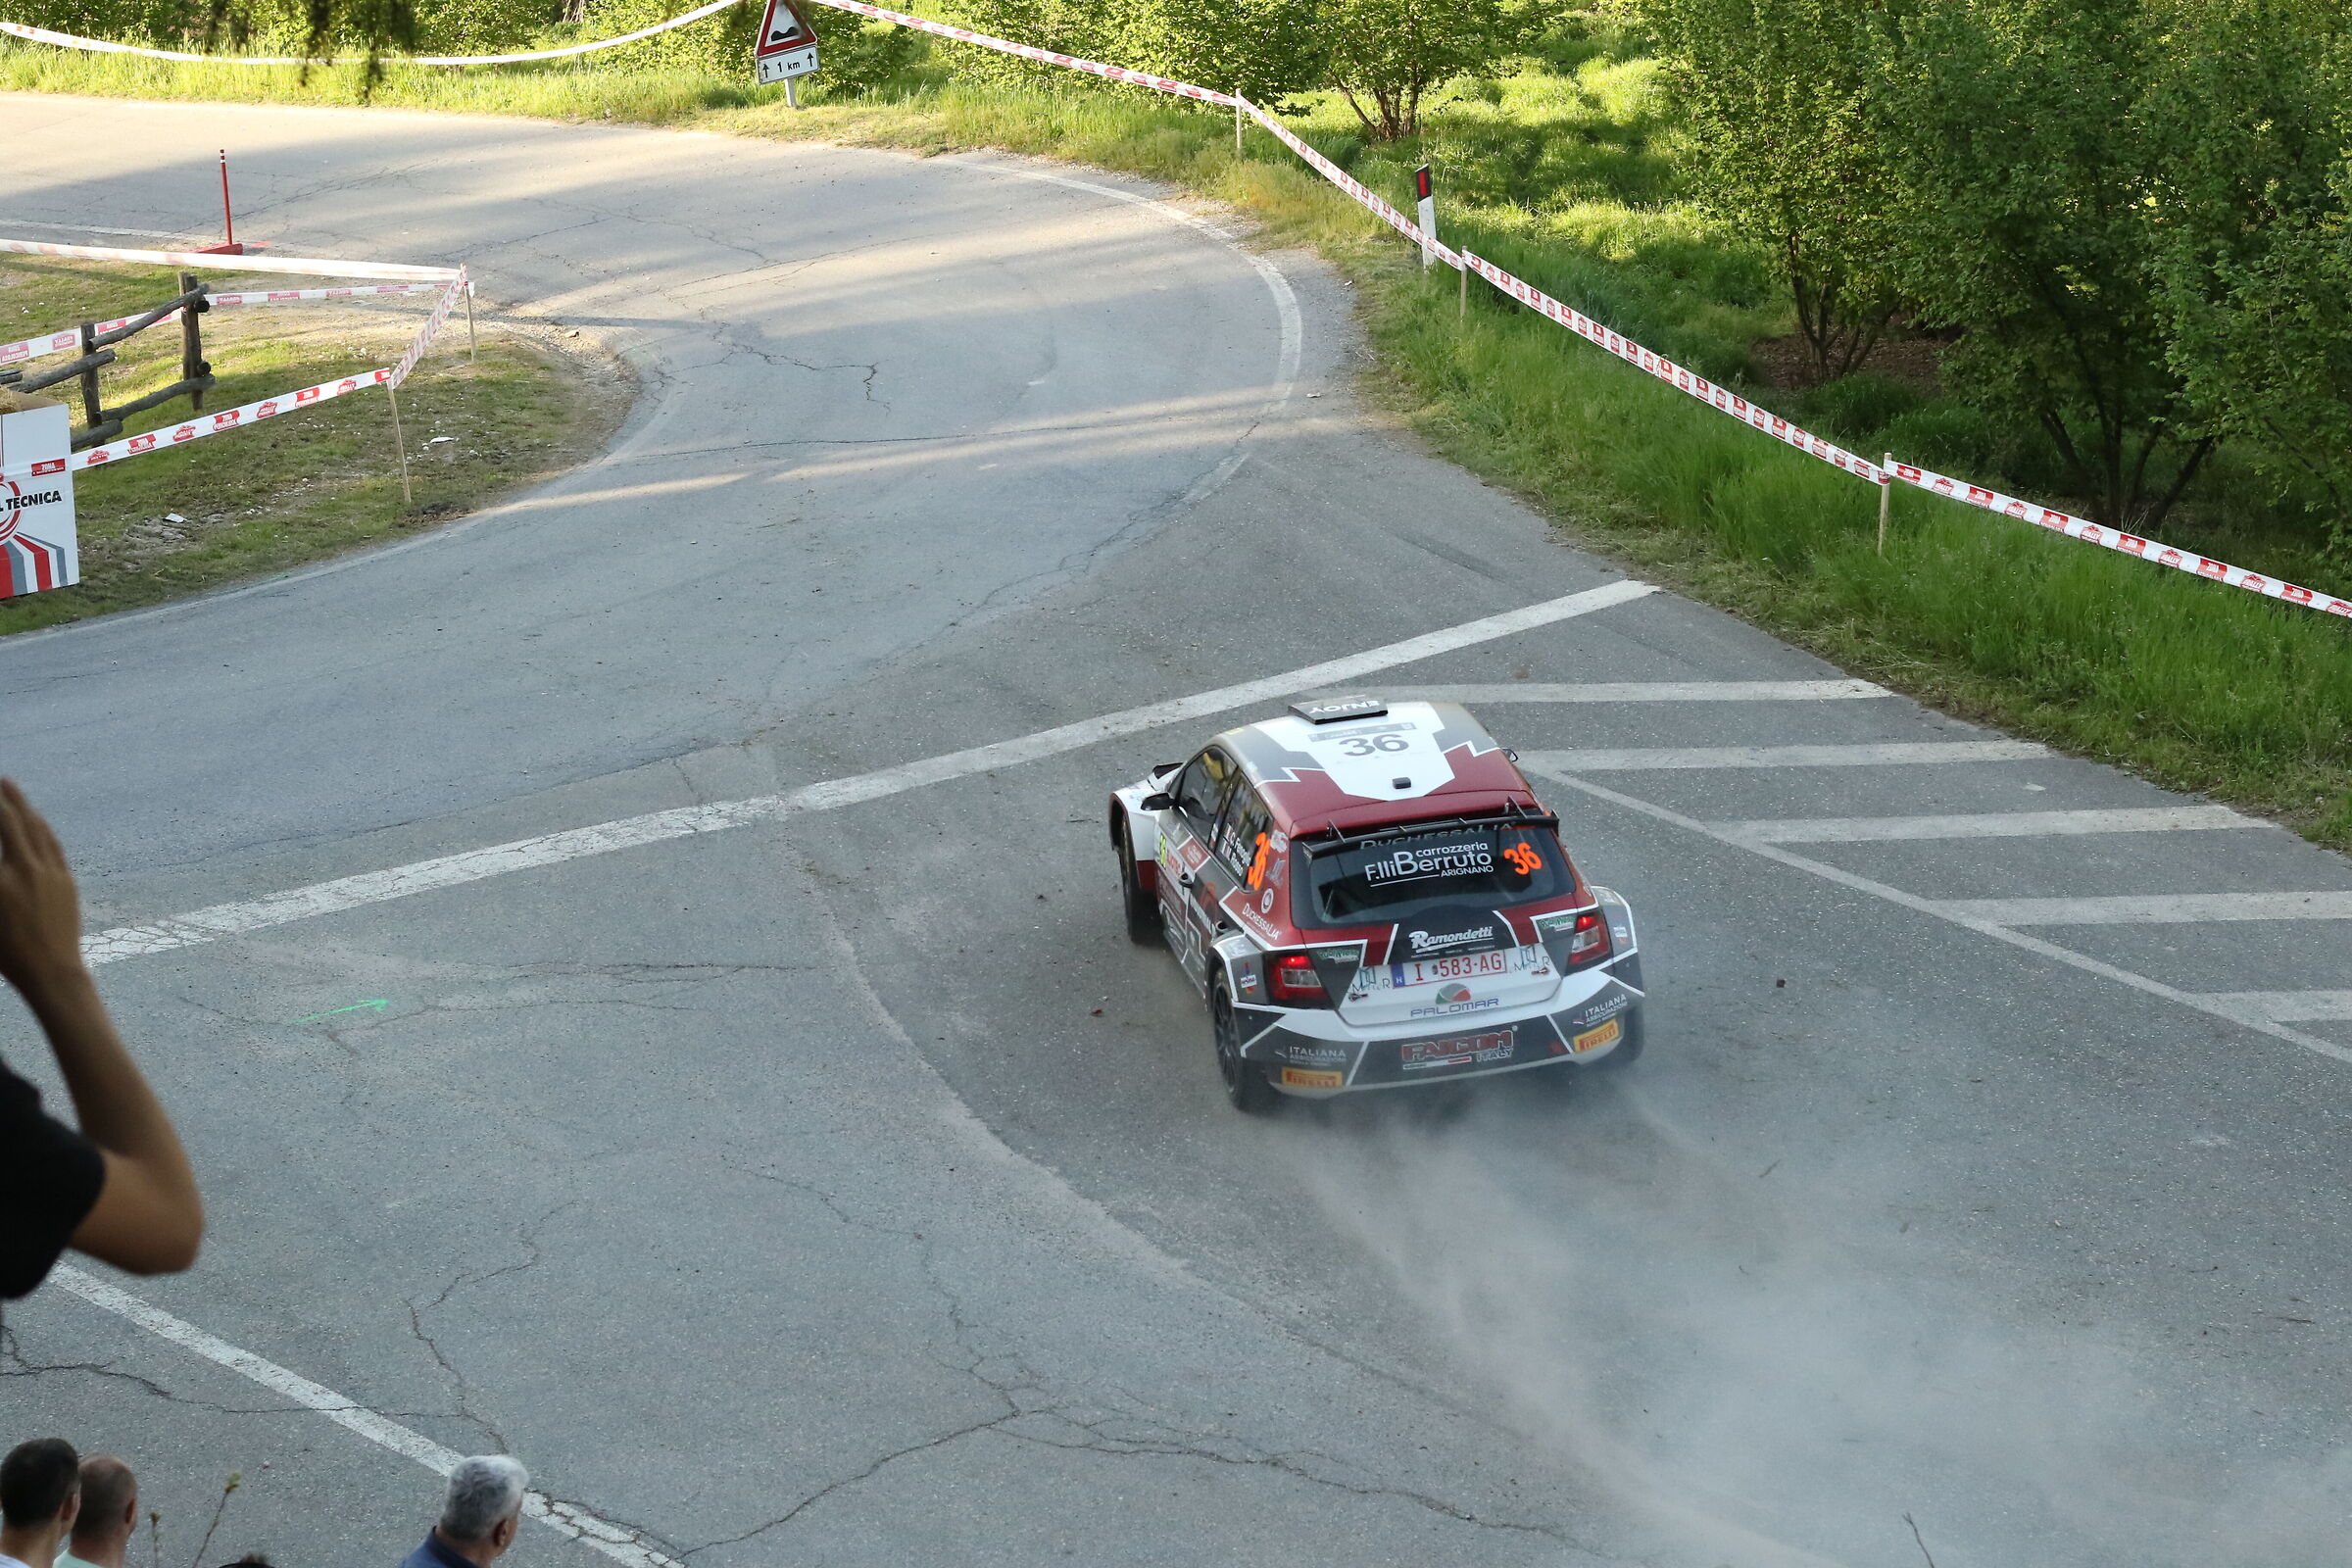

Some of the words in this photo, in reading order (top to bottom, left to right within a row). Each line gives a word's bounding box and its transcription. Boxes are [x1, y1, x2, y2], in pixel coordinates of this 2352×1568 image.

[777, 62, 782, 73] 1
[787, 61, 801, 71] km
[6, 490, 62, 511] TECNICA
[1308, 700, 1380, 714] ENJOY
[1339, 734, 1409, 757] 36
[1415, 842, 1489, 858] carrozzeria
[1502, 842, 1543, 875] 36
[1247, 831, 1272, 891] 36
[1440, 865, 1494, 878] ARIGNANO
[1408, 926, 1494, 949] Ramondetti
[1410, 998, 1499, 1017] PALOMAR
[1585, 994, 1627, 1017] ITALIANA
[1579, 1023, 1618, 1052] PIRELLI
[1289, 1046, 1347, 1057] ITALIANA
[1476, 1046, 1513, 1062] ITALY
[1285, 1070, 1338, 1087] PIRELLI
